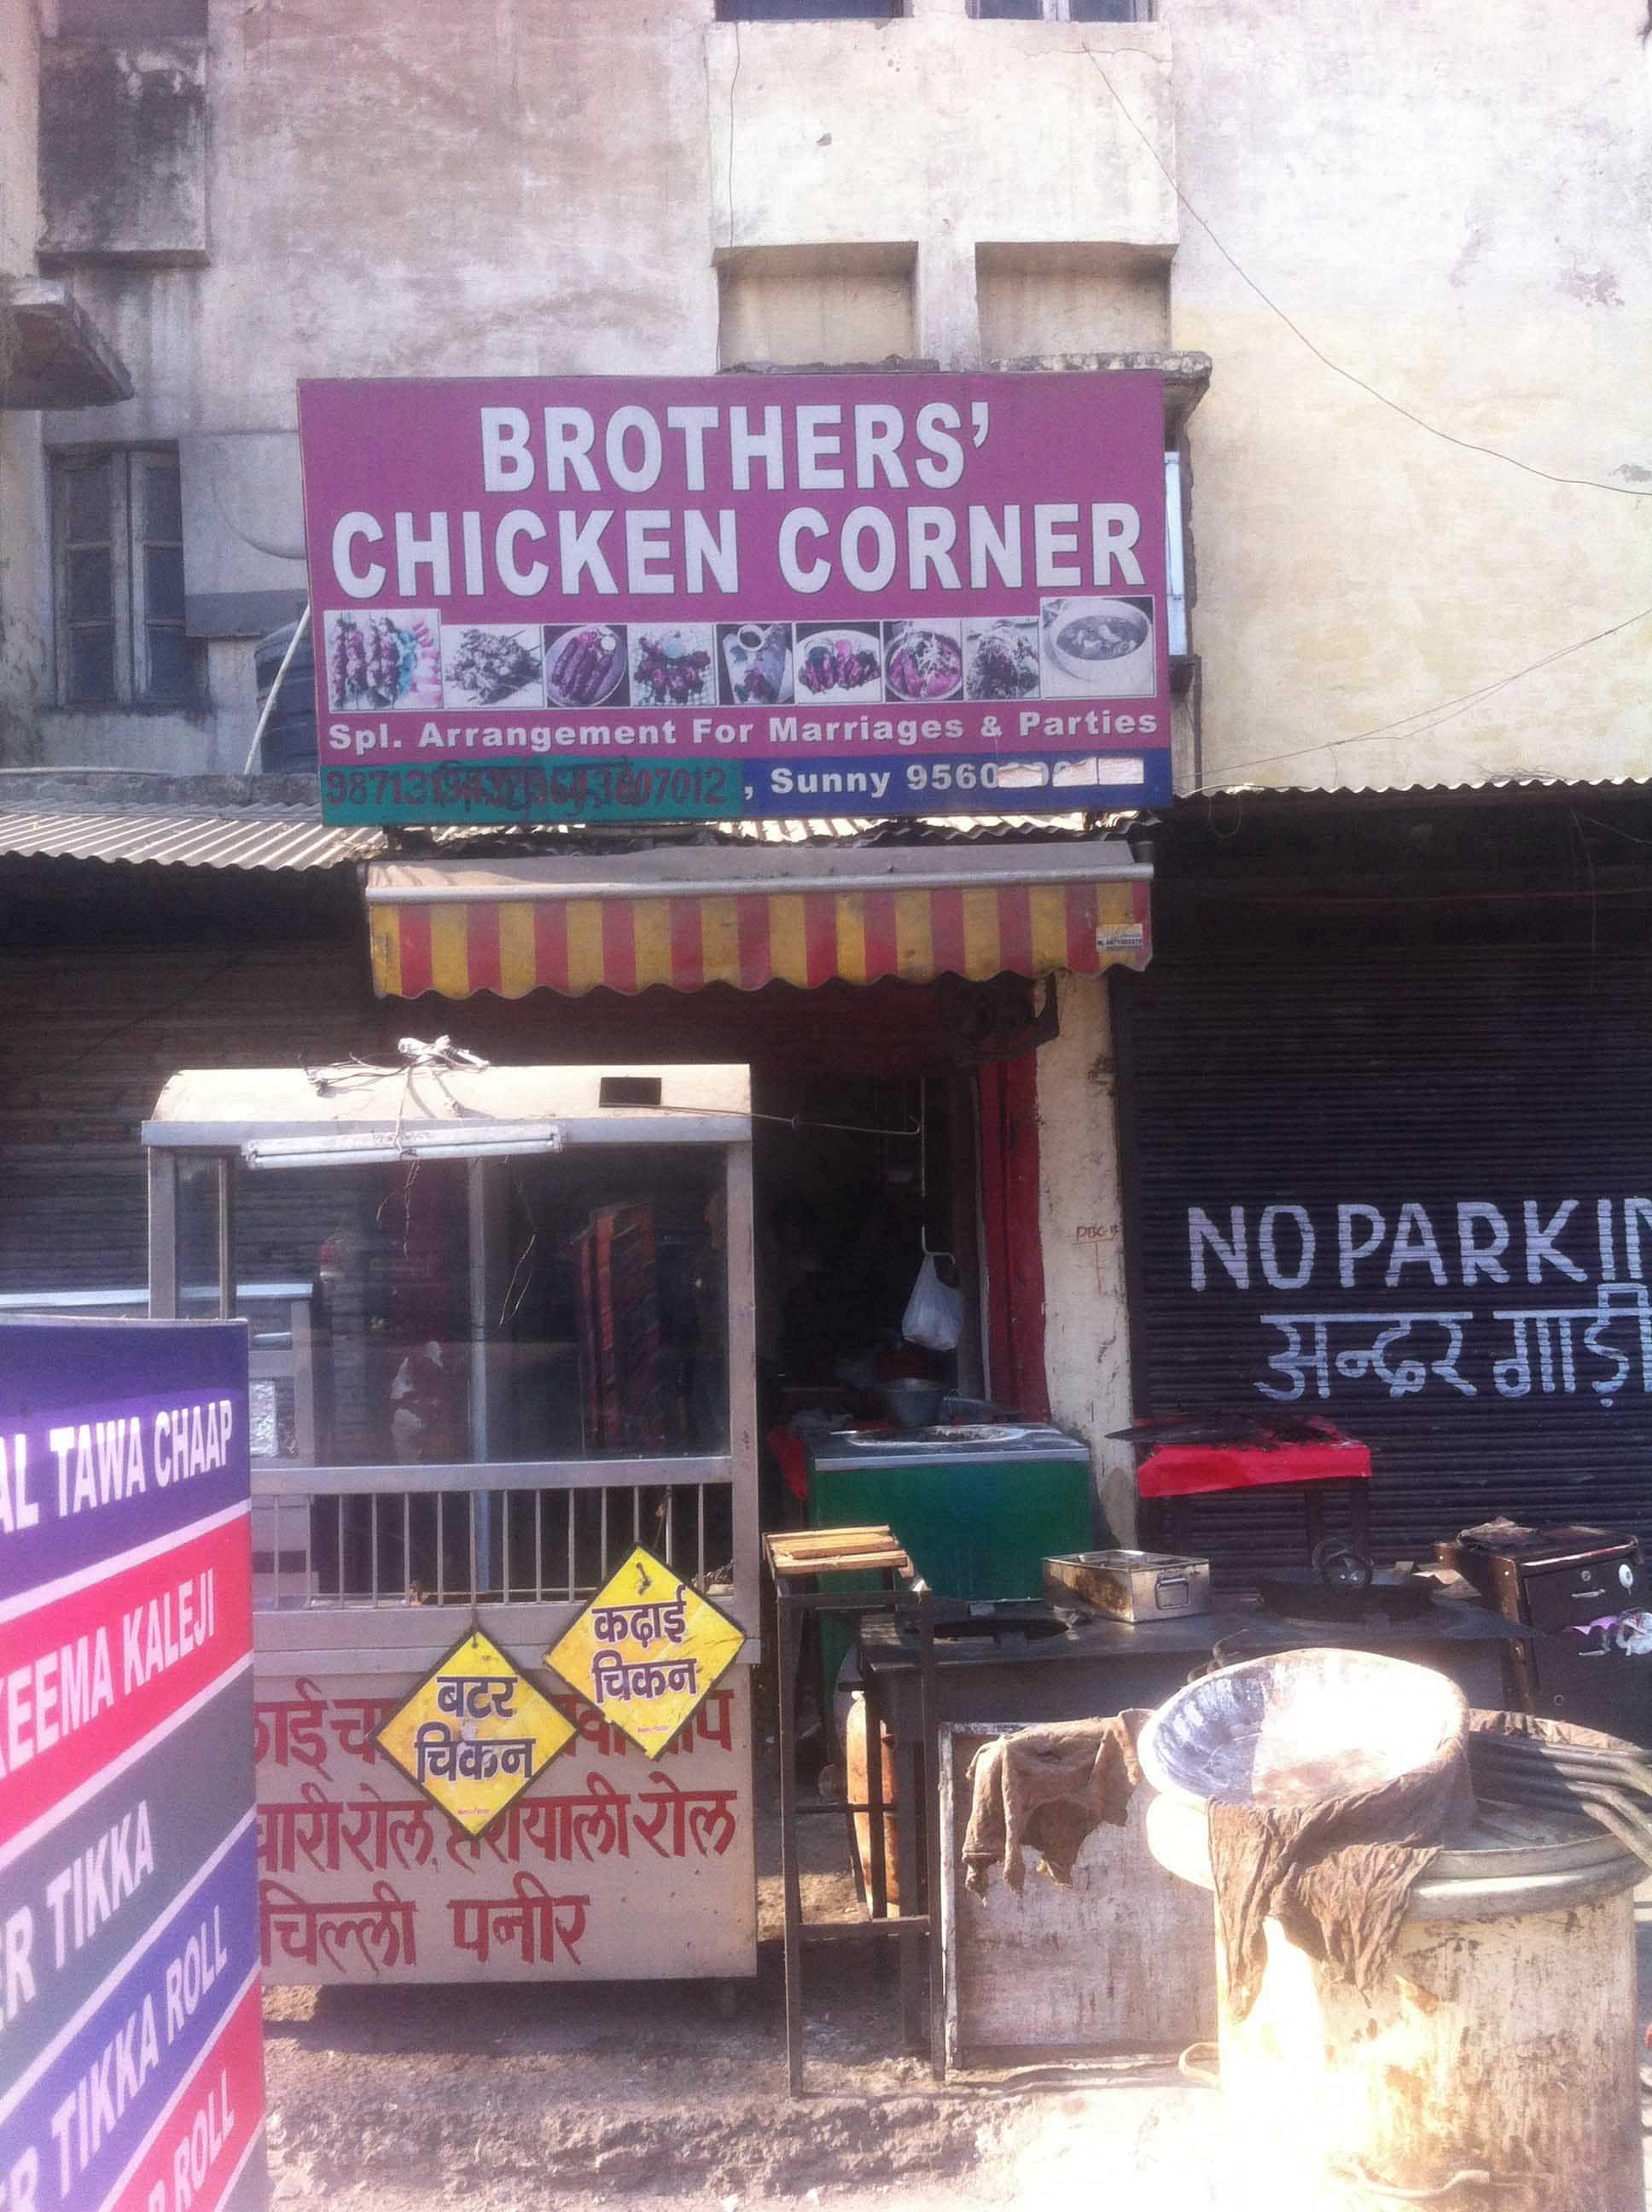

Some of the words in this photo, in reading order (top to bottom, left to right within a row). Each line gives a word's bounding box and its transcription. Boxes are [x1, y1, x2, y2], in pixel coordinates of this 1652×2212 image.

[332, 509, 741, 600] CHICKEN
[777, 501, 1146, 596] CORNER
[329, 723, 403, 754] Spl.
[418, 719, 678, 753] Arrangement
[692, 719, 753, 744] For
[769, 715, 964, 747] Marriages
[981, 715, 1003, 737] &
[1020, 711, 1158, 736] Parties
[771, 767, 892, 799] Sunny
[1188, 1204, 1316, 1291] NO
[49, 1417, 146, 1517] TAWA
[154, 1400, 232, 1487] CHAAP
[0, 1626, 114, 1779] EEMA
[123, 1567, 214, 1695] KALEJI
[436, 1675, 518, 1718] बटर
[591, 1649, 697, 1704] चिकन
[414, 1721, 536, 1783] चिकन
[633, 1771, 737, 1859] रोल
[46, 1800, 154, 1970] TIKKA
[447, 1871, 591, 1965] पनीर
[51, 1993, 160, 2200] TIKKA
[166, 1905, 228, 2046] ROLL
[173, 2069, 236, 2212] ROLL
